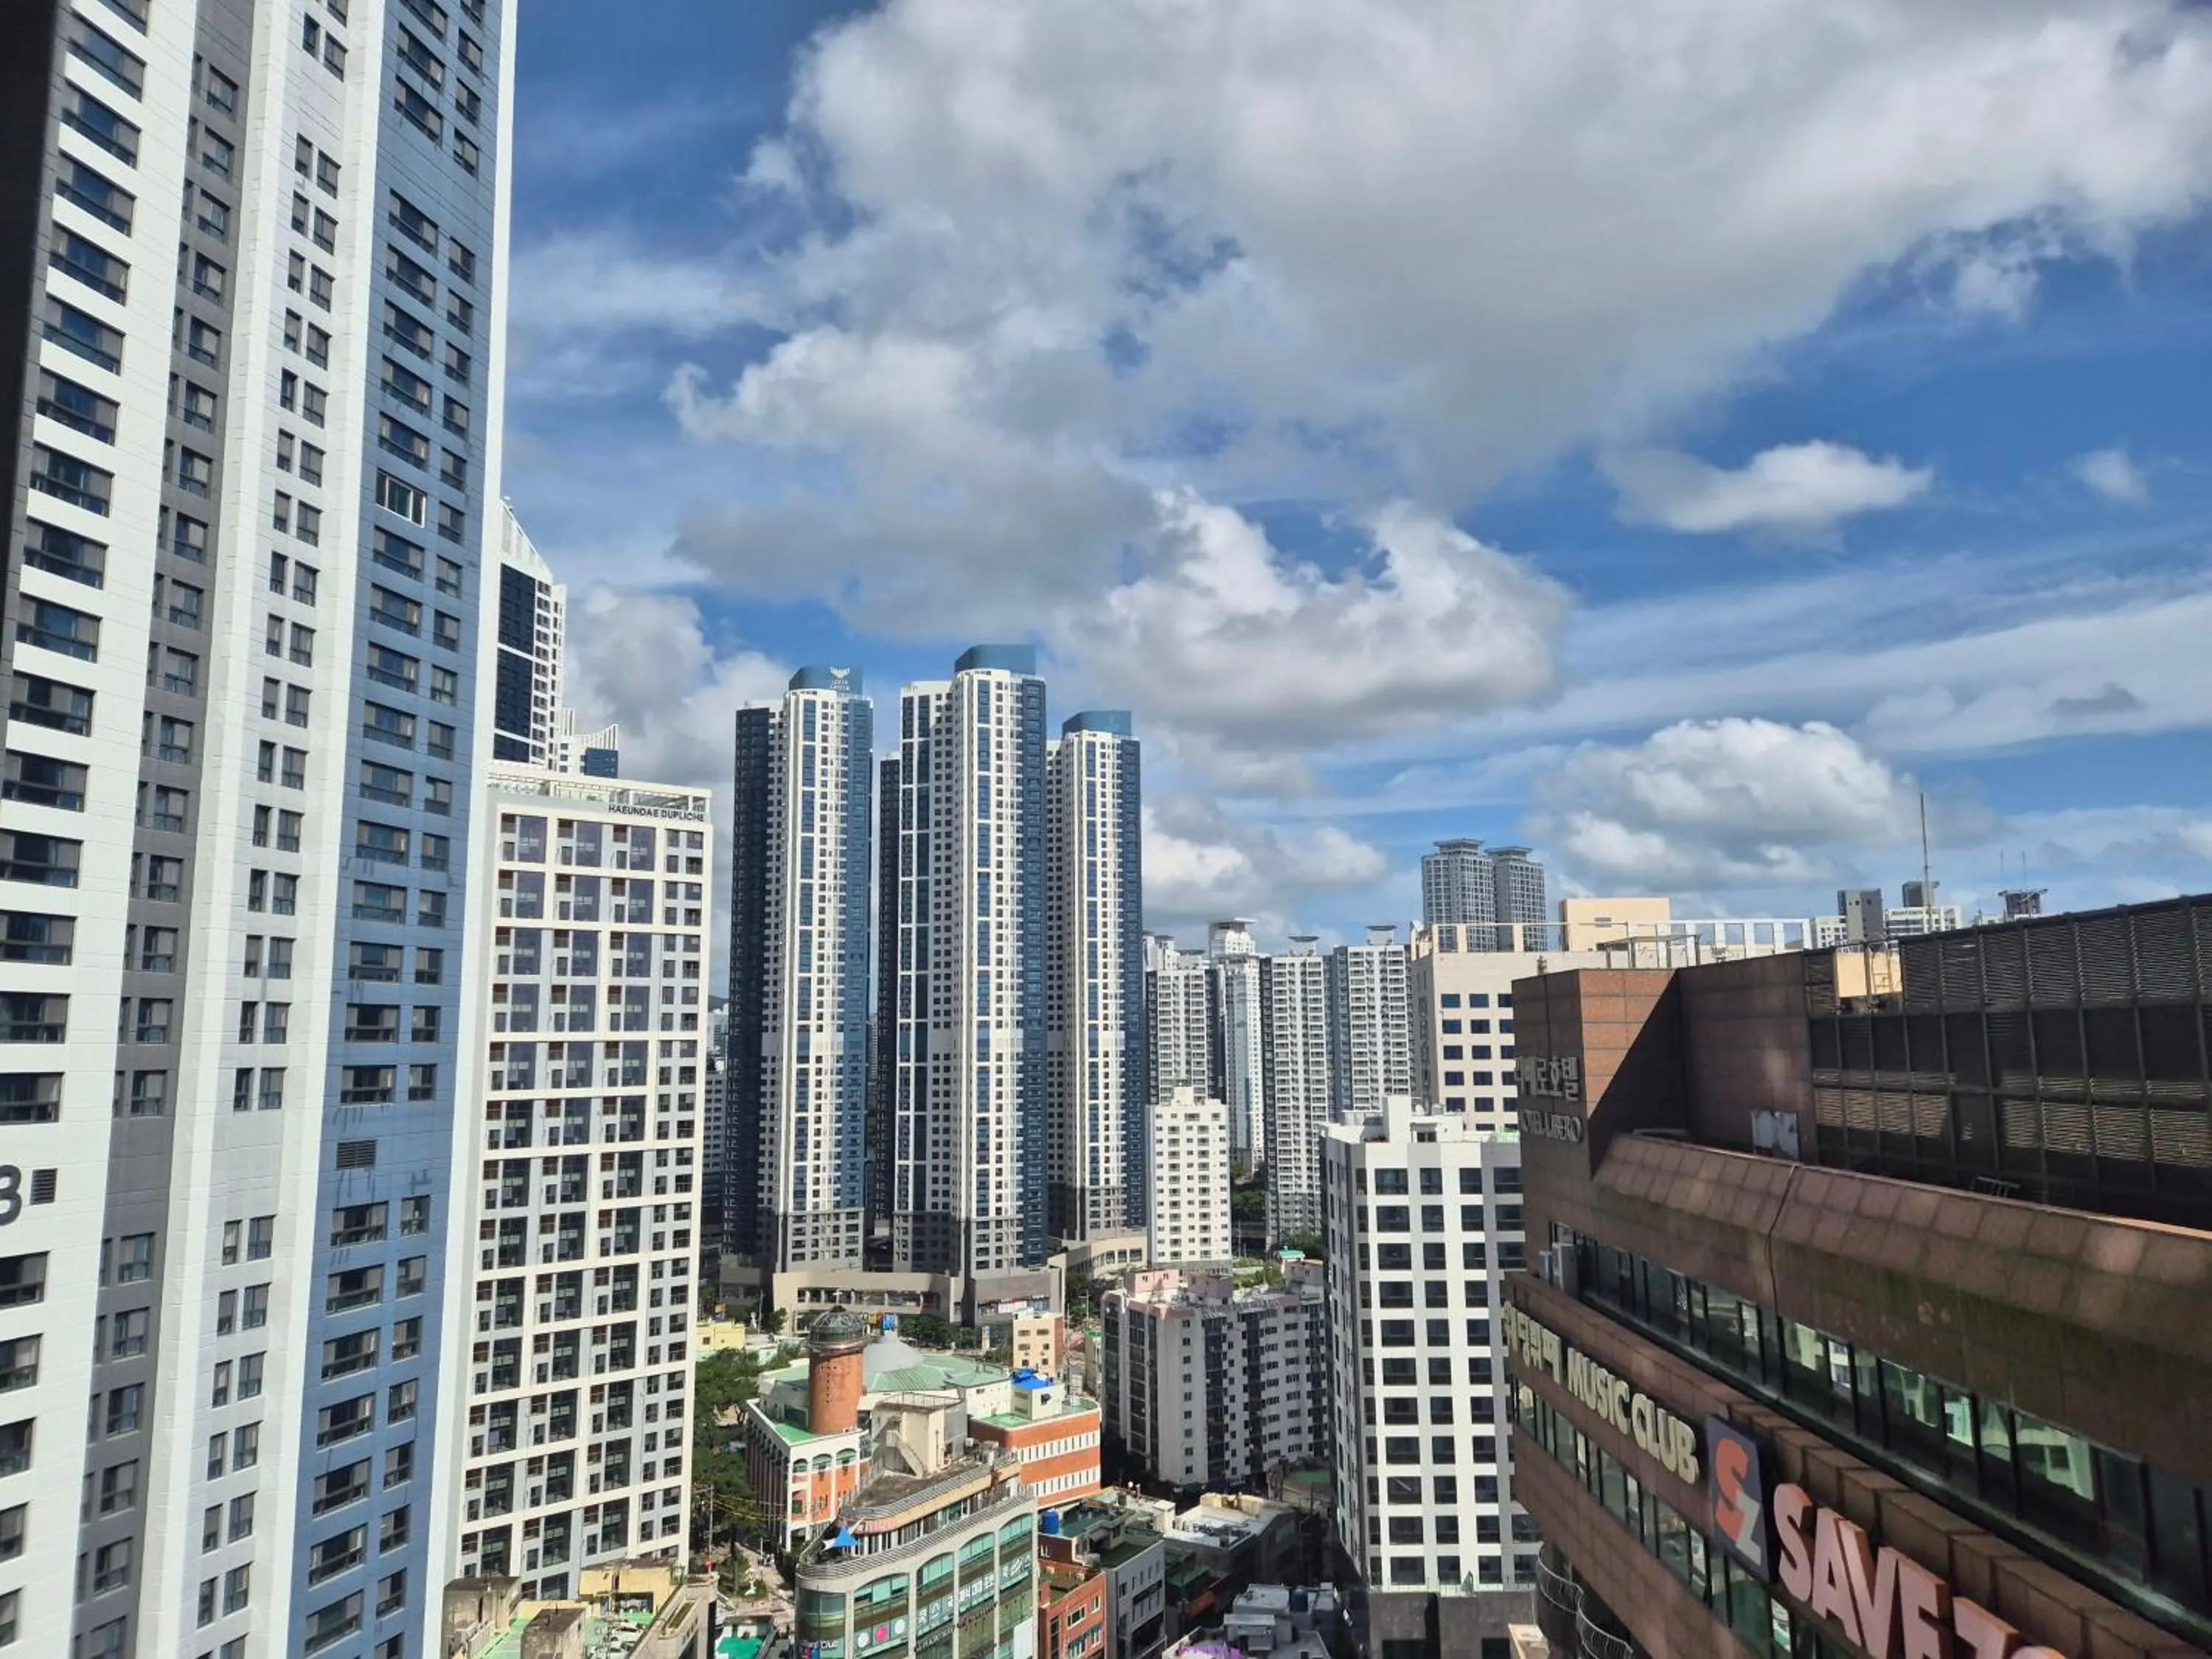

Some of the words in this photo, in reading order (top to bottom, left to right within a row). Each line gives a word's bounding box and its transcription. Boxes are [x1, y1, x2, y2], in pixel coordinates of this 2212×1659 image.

[608, 804, 659, 818] HAEUNDAE
[1567, 1347, 1630, 1436] MUSIC
[1632, 1393, 1700, 1485] CLUB
